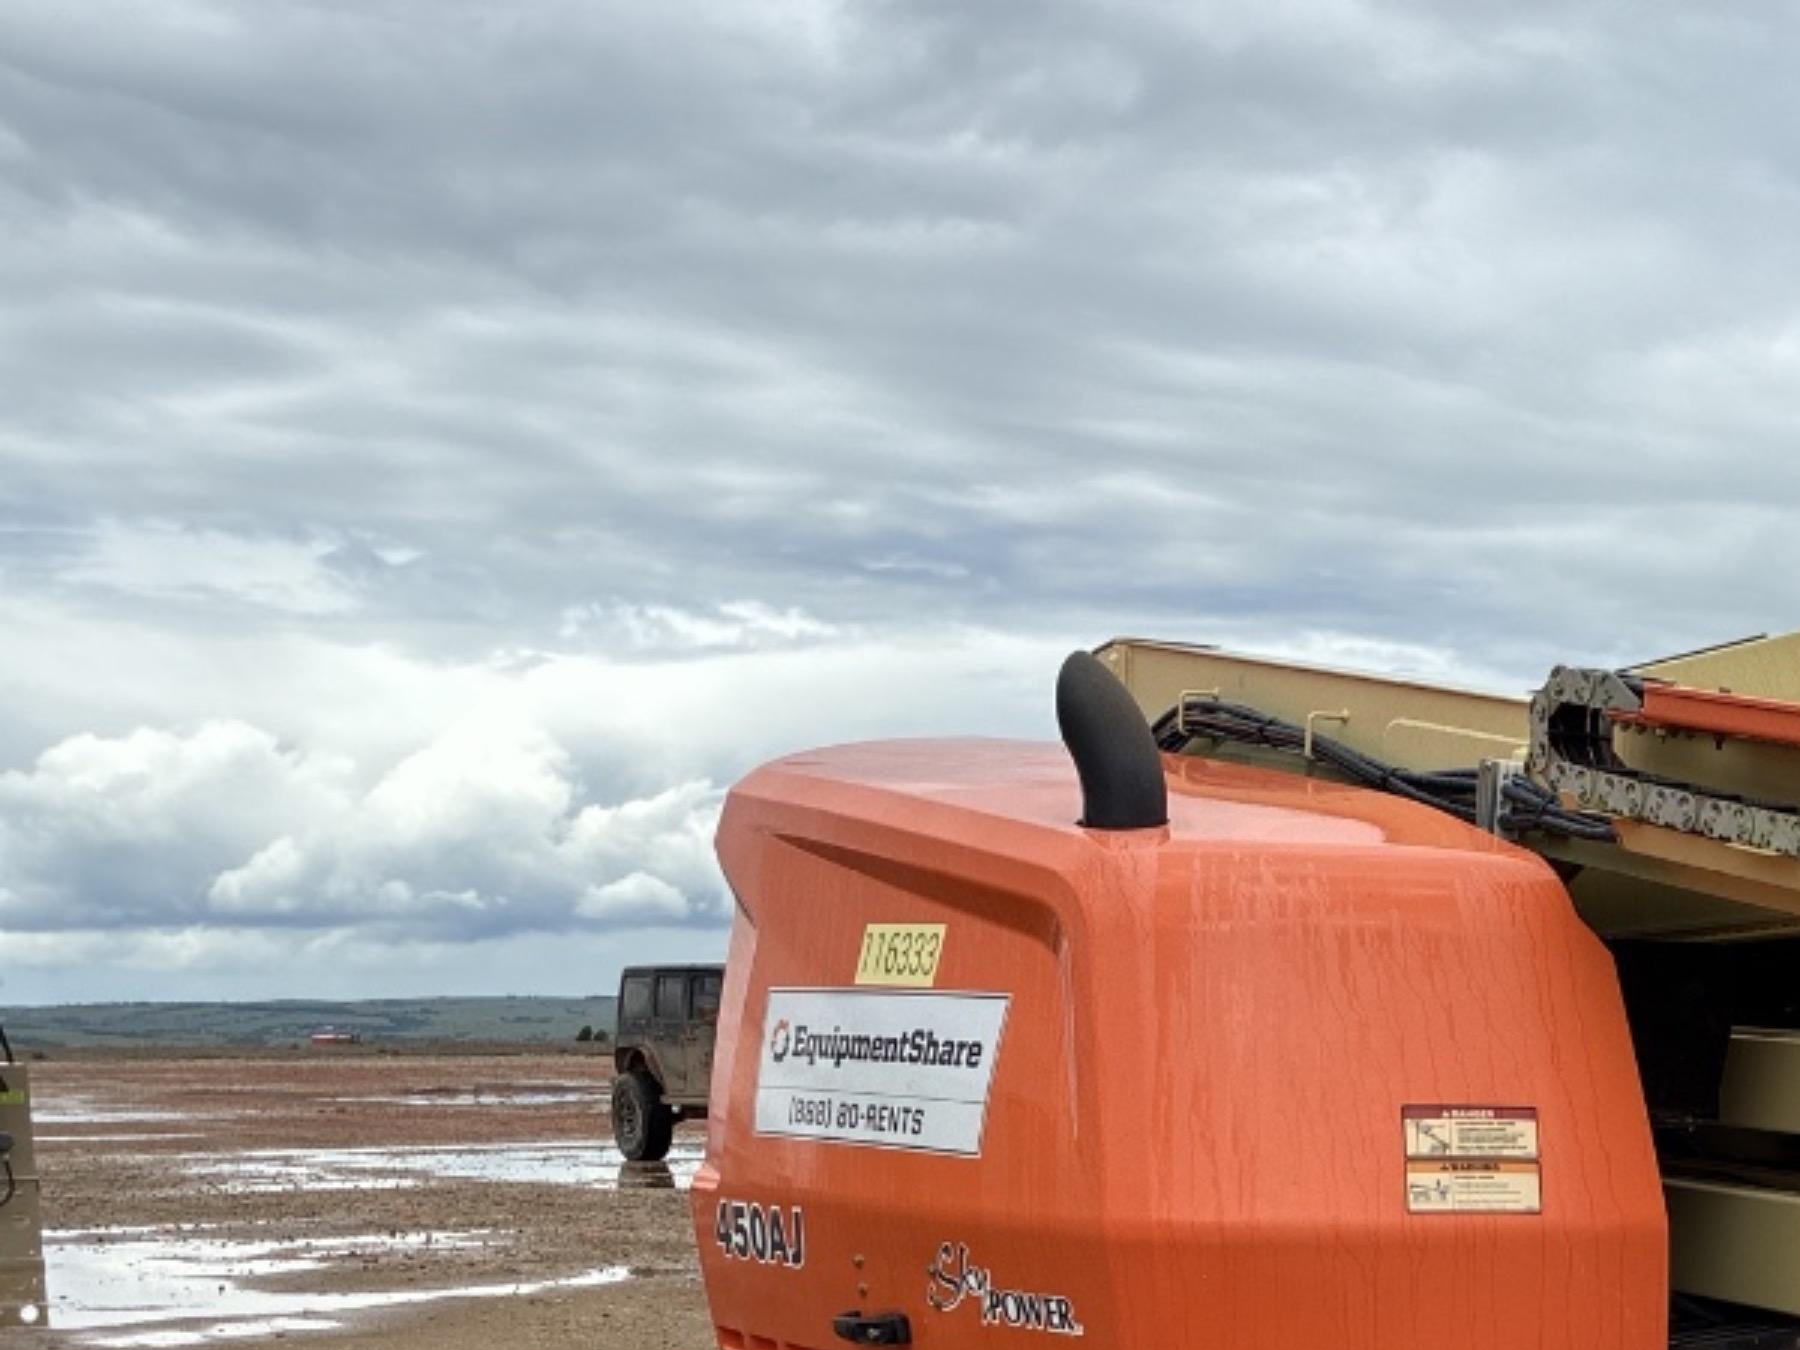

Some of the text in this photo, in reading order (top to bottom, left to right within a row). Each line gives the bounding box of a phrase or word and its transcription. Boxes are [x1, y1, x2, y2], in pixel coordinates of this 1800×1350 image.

[862, 932, 940, 976] 116333
[791, 1025, 983, 1069] EquipmentShare
[717, 1199, 804, 1269] 450AJ
